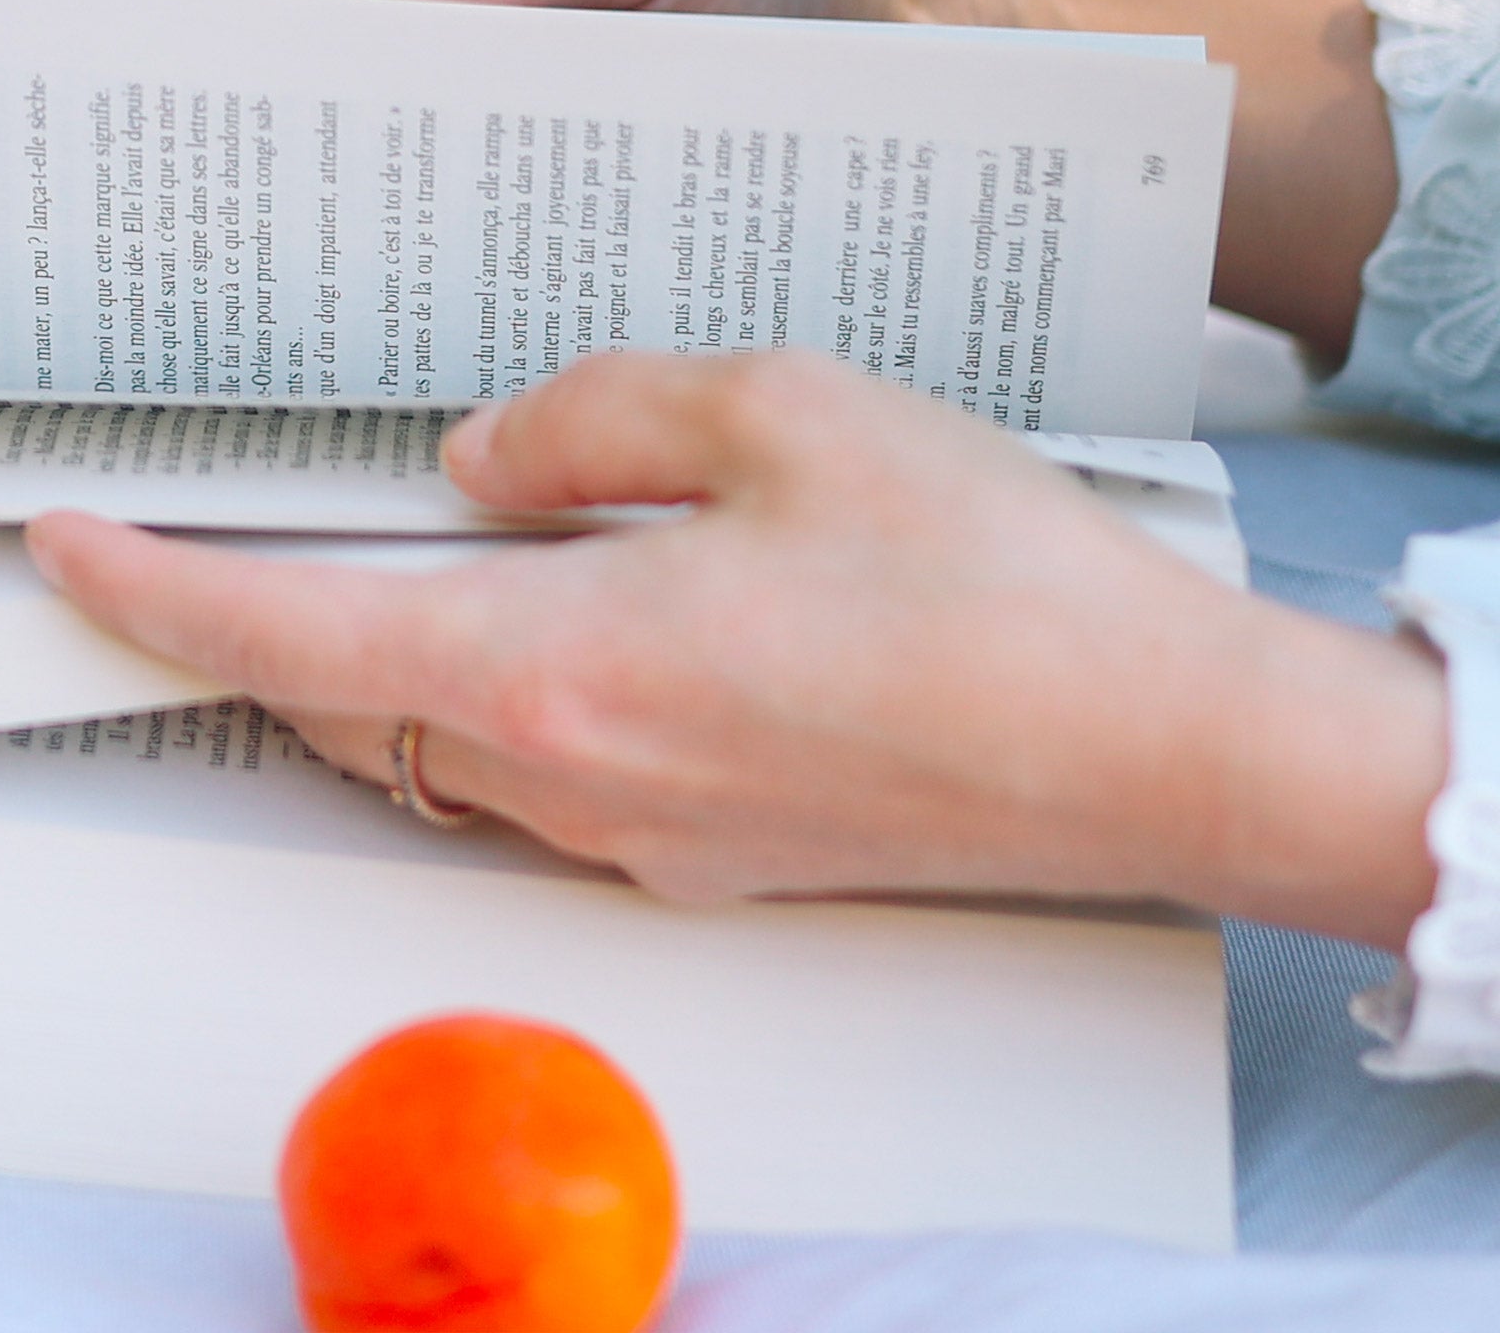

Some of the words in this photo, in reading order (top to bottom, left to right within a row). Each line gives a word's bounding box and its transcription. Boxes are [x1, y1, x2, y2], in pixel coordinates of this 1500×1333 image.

[121, 147, 142, 197] l'avait
[412, 109, 435, 202] transforme
[509, 154, 531, 195] dans
[542, 118, 569, 227] joyeusement
[779, 133, 801, 196] soyeuse
[1009, 145, 1033, 196] grand
[1144, 154, 1166, 185] 769
[24, 136, 51, 230] lança-t-elle
[96, 163, 117, 228] marque
[381, 189, 401, 210] toi
[476, 171, 498, 200] elle
[673, 173, 695, 209] bras
[873, 177, 894, 210] vois
[911, 174, 927, 205] une
[121, 202, 143, 234] Elle
[153, 194, 174, 243] c'était
[185, 185, 206, 225] dans
[256, 192, 270, 214] un
[575, 193, 595, 230] trois
[605, 187, 628, 237] faisait
[969, 163, 997, 270] compliments
[1004, 203, 1025, 228] Un
[1044, 194, 1064, 223] par
[216, 196, 244, 250] qu'elle
[315, 191, 342, 276] impatient,
[506, 202, 530, 280] déboucha
[743, 216, 764, 244] pas
[769, 202, 793, 253] boucle
[33, 249, 55, 279] peu
[94, 234, 112, 273] cette
[122, 239, 143, 277] idée.
[187, 230, 213, 273] signe
[224, 257, 238, 275] ce
[249, 219, 277, 283] prendre
[379, 230, 401, 264] c'est
[418, 254, 432, 274] ou
[572, 238, 594, 265] fait
[604, 243, 626, 257] la
[671, 235, 693, 281] tendit
[768, 258, 790, 272] la
[869, 239, 890, 259] Je
[1003, 236, 1023, 273] tout.
[155, 247, 179, 297] savait,
[538, 235, 567, 303] s'agitant
[578, 271, 599, 298] pas
[608, 263, 625, 278] et
[702, 234, 725, 299] cheveux
[734, 249, 756, 317] semblait
[831, 241, 857, 306] derrière
[867, 263, 889, 301] côté.
[900, 224, 924, 310] ressembles
[1034, 229, 1059, 330] commençant
[34, 285, 49, 306] un
[98, 279, 119, 308] que
[193, 277, 207, 295] ce
[314, 283, 342, 324] doigt
[379, 269, 405, 313] boire,
[410, 281, 432, 296] là
[510, 287, 527, 302] et
[669, 287, 691, 298] il
[968, 275, 987, 326] suaves
[99, 313, 113, 330] ce
[122, 282, 144, 347] moindre
[217, 282, 245, 338] jusqu'à
[256, 287, 277, 325] pour
[410, 302, 431, 321] de
[474, 292, 496, 340] tunnel
[603, 282, 630, 340] poignet
[670, 303, 695, 336] puis
[863, 305, 885, 318] le
[899, 313, 917, 330] tu
[995, 280, 1024, 333] malgré
[33, 311, 54, 362] mater,
[154, 301, 182, 350] qu'elle
[386, 318, 400, 338] ou
[506, 308, 527, 351] sortie
[536, 311, 559, 375] lanterne
[570, 304, 592, 354] n'avait
[700, 306, 728, 347] longs
[738, 321, 753, 340] ne
[830, 314, 857, 361] visage
[869, 322, 884, 347] sur
[93, 336, 115, 392] Dis-moi
[123, 352, 145, 365] la
[217, 344, 238, 369] fait
[314, 331, 335, 364] d'un
[379, 341, 400, 386] Parier
[413, 327, 437, 372] pattes
[473, 344, 494, 363] du
[504, 357, 525, 371] la
[893, 333, 915, 369] Mais
[956, 330, 982, 381] d'aussi
[996, 339, 1018, 377] nom,
[1029, 334, 1047, 375] noms
[37, 367, 52, 390] me
[131, 369, 152, 394] pas
[155, 353, 176, 394] chose
[413, 378, 430, 398] tes
[472, 367, 494, 399] bout
[987, 383, 1009, 397] le
[1020, 379, 1042, 404] des
